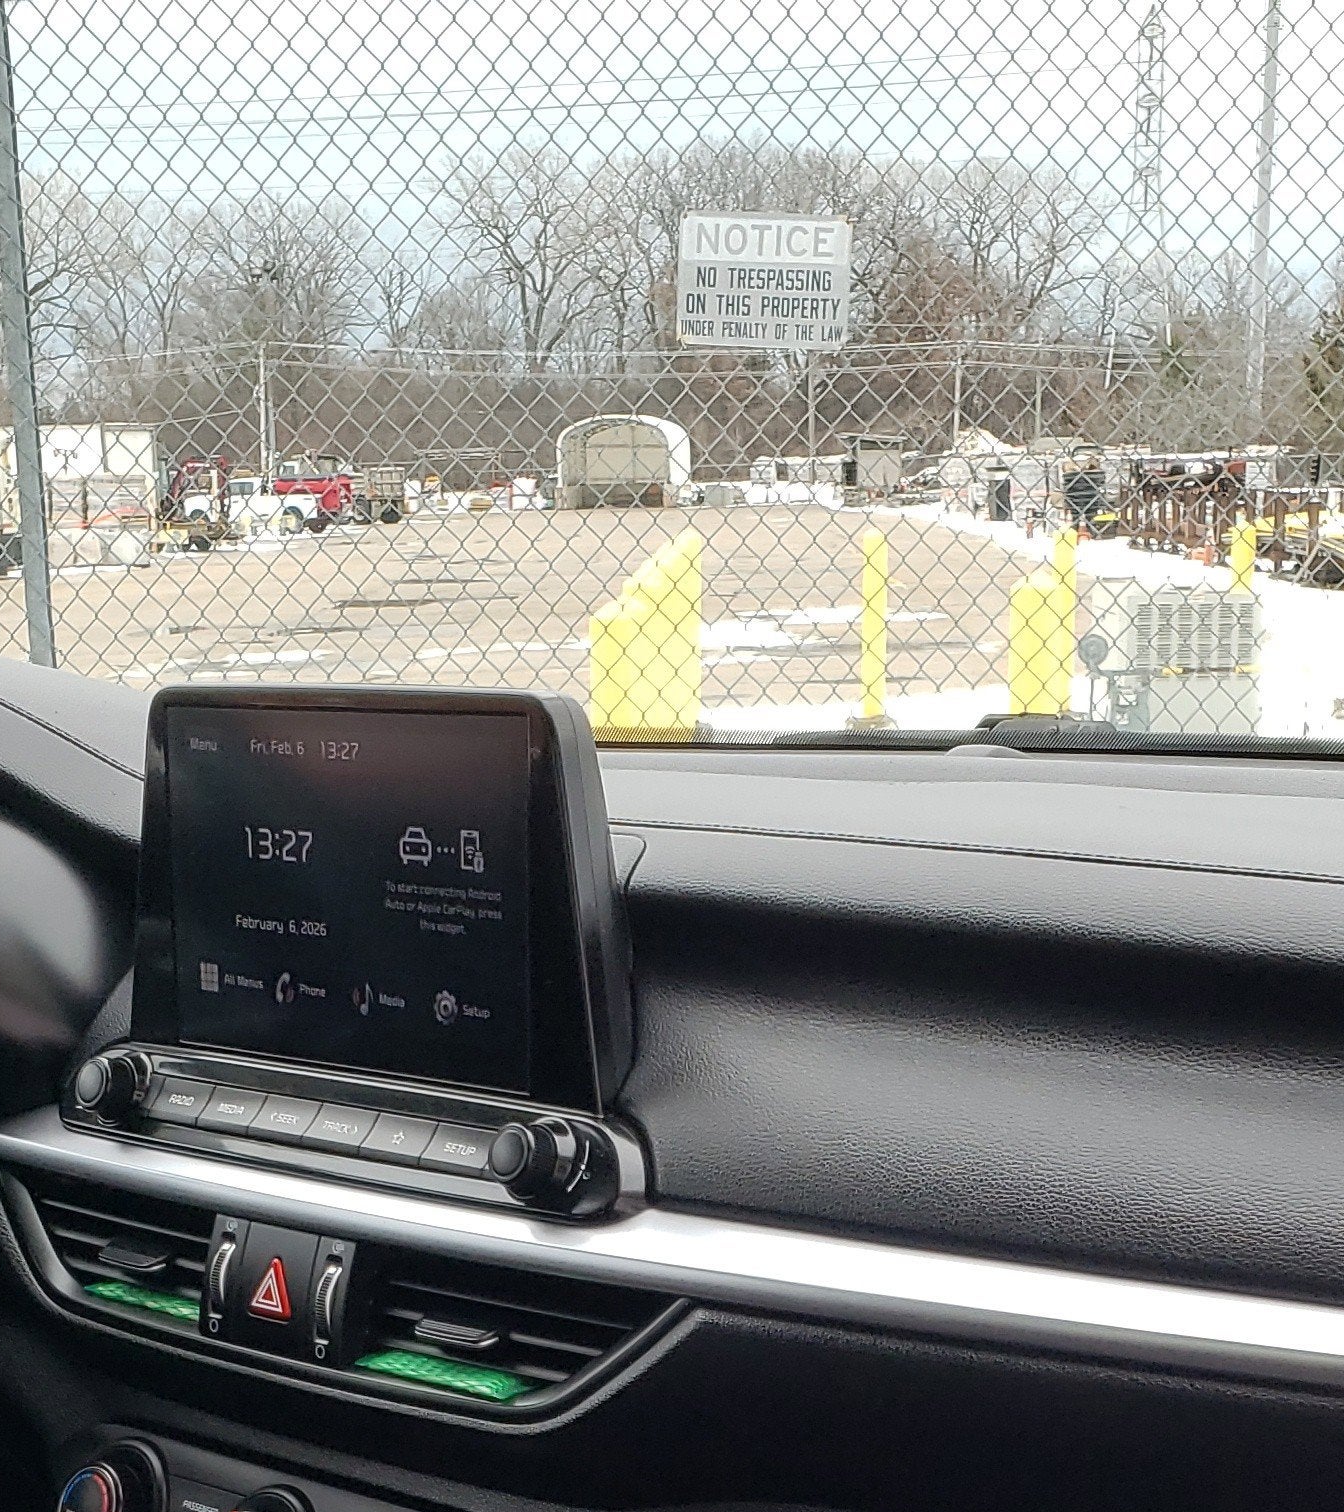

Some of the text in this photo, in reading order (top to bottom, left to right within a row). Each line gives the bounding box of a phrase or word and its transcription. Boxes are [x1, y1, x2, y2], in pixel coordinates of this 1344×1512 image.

[696, 222, 835, 258] NOTICE
[696, 266, 832, 292] NO TRESPASSING
[686, 293, 841, 320] ON THIS PROPERTY
[680, 319, 843, 343] UNDER PENALTY OF THE LAW
[297, 741, 305, 755] 6
[320, 741, 359, 760] 13:27
[243, 826, 314, 863] 13:27
[235, 914, 284, 935] February
[300, 921, 328, 937] 2026
[217, 1102, 245, 1115] MEDIA
[443, 1142, 476, 1155] SETUP
